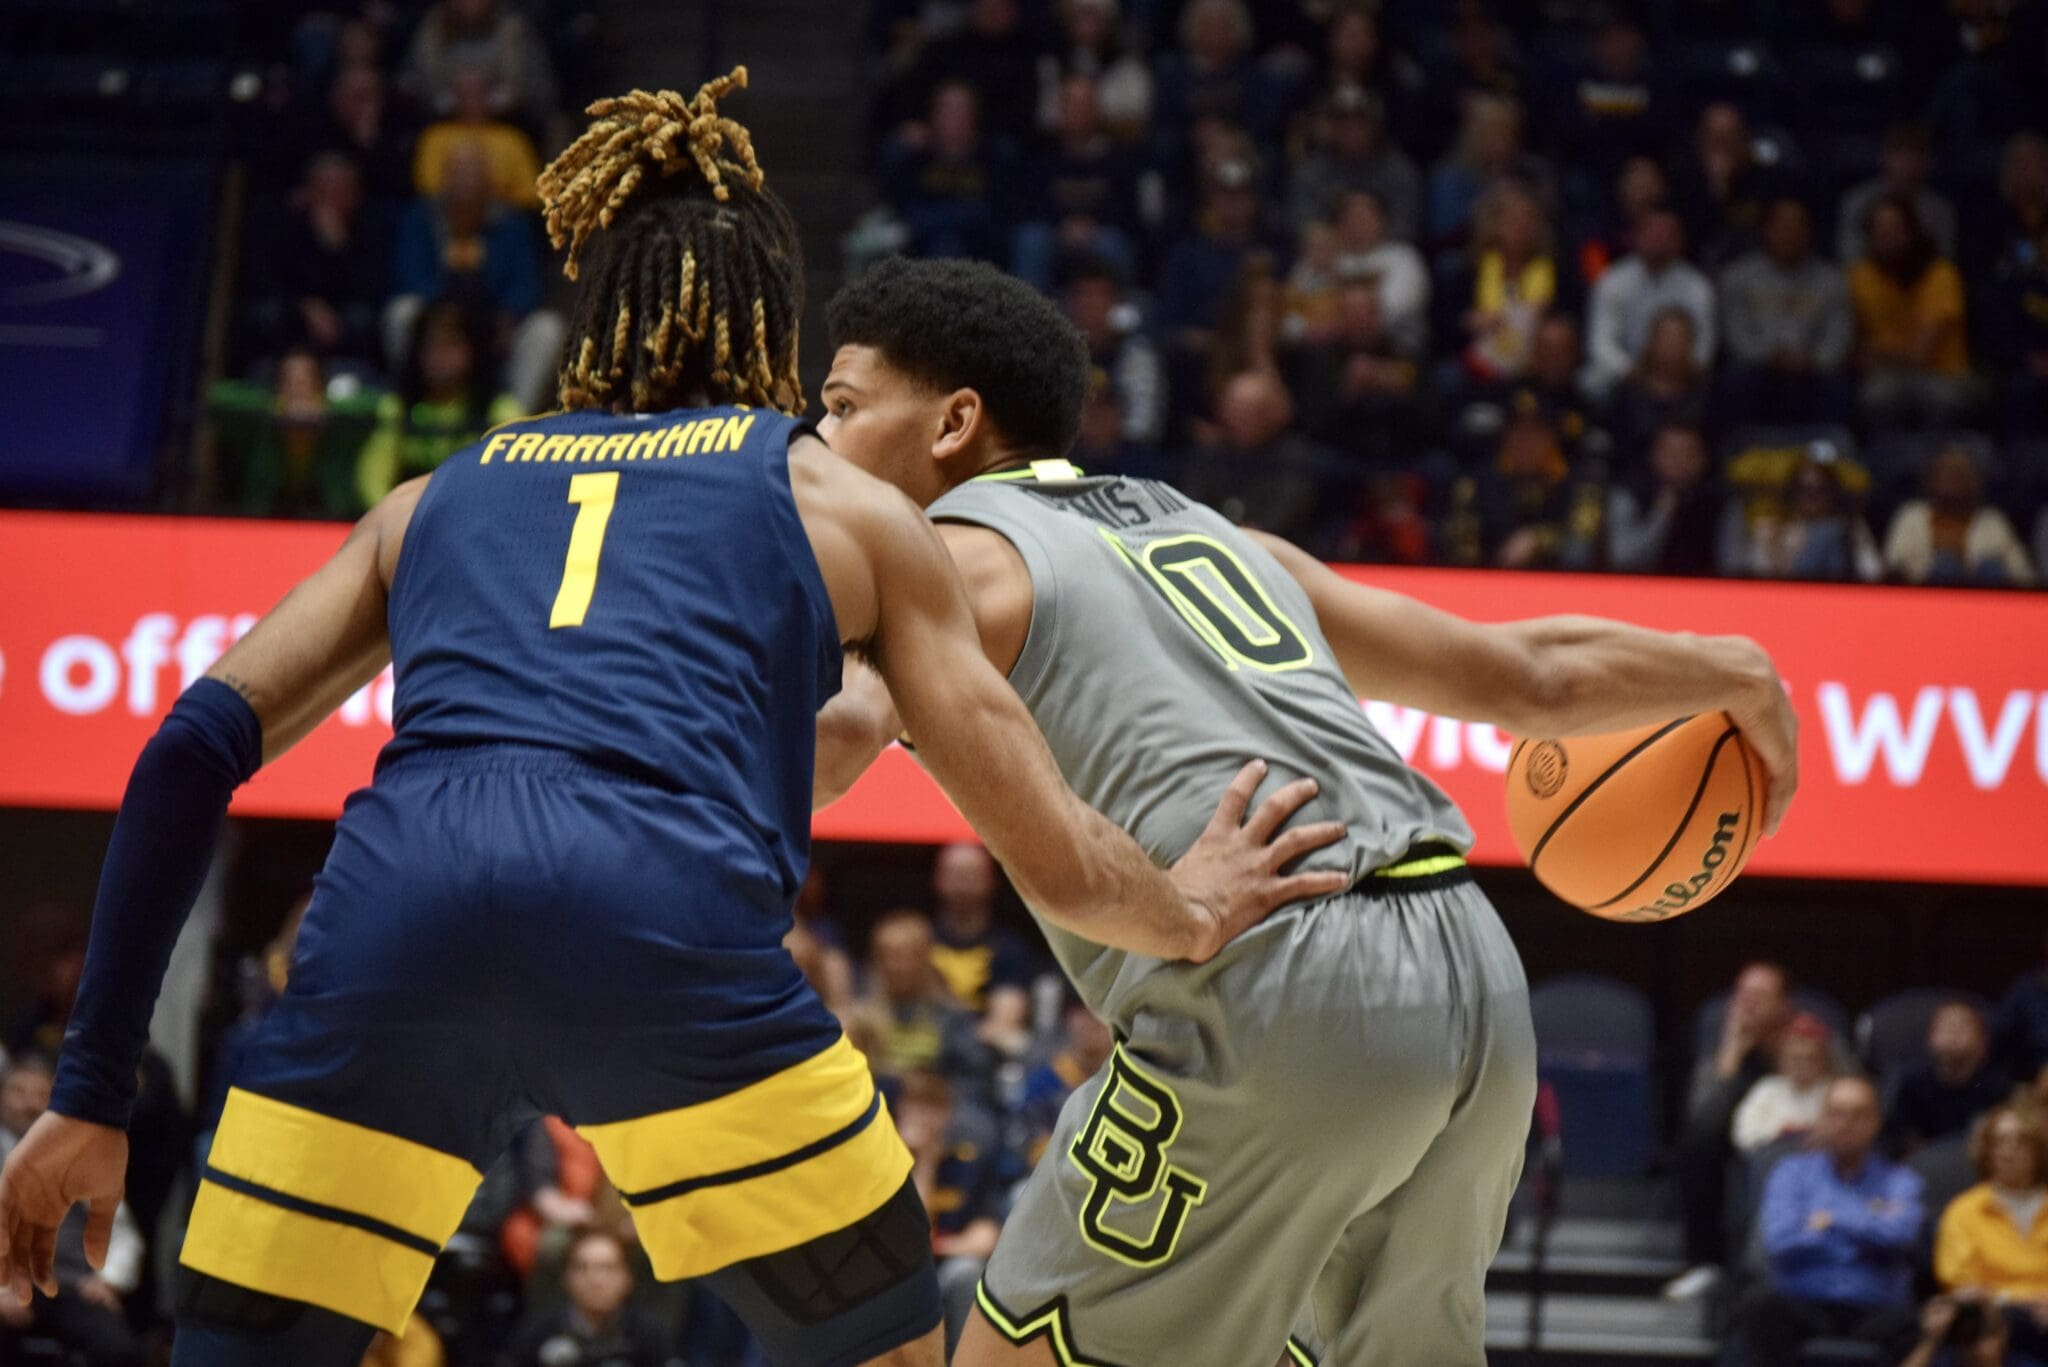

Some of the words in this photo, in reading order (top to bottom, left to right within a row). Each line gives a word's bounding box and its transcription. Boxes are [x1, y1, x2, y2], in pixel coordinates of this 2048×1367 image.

[479, 415, 756, 465] FARRAKHAN
[549, 471, 620, 630] 1
[1816, 680, 2048, 790] WV
[1067, 1041, 1208, 1269] BU
